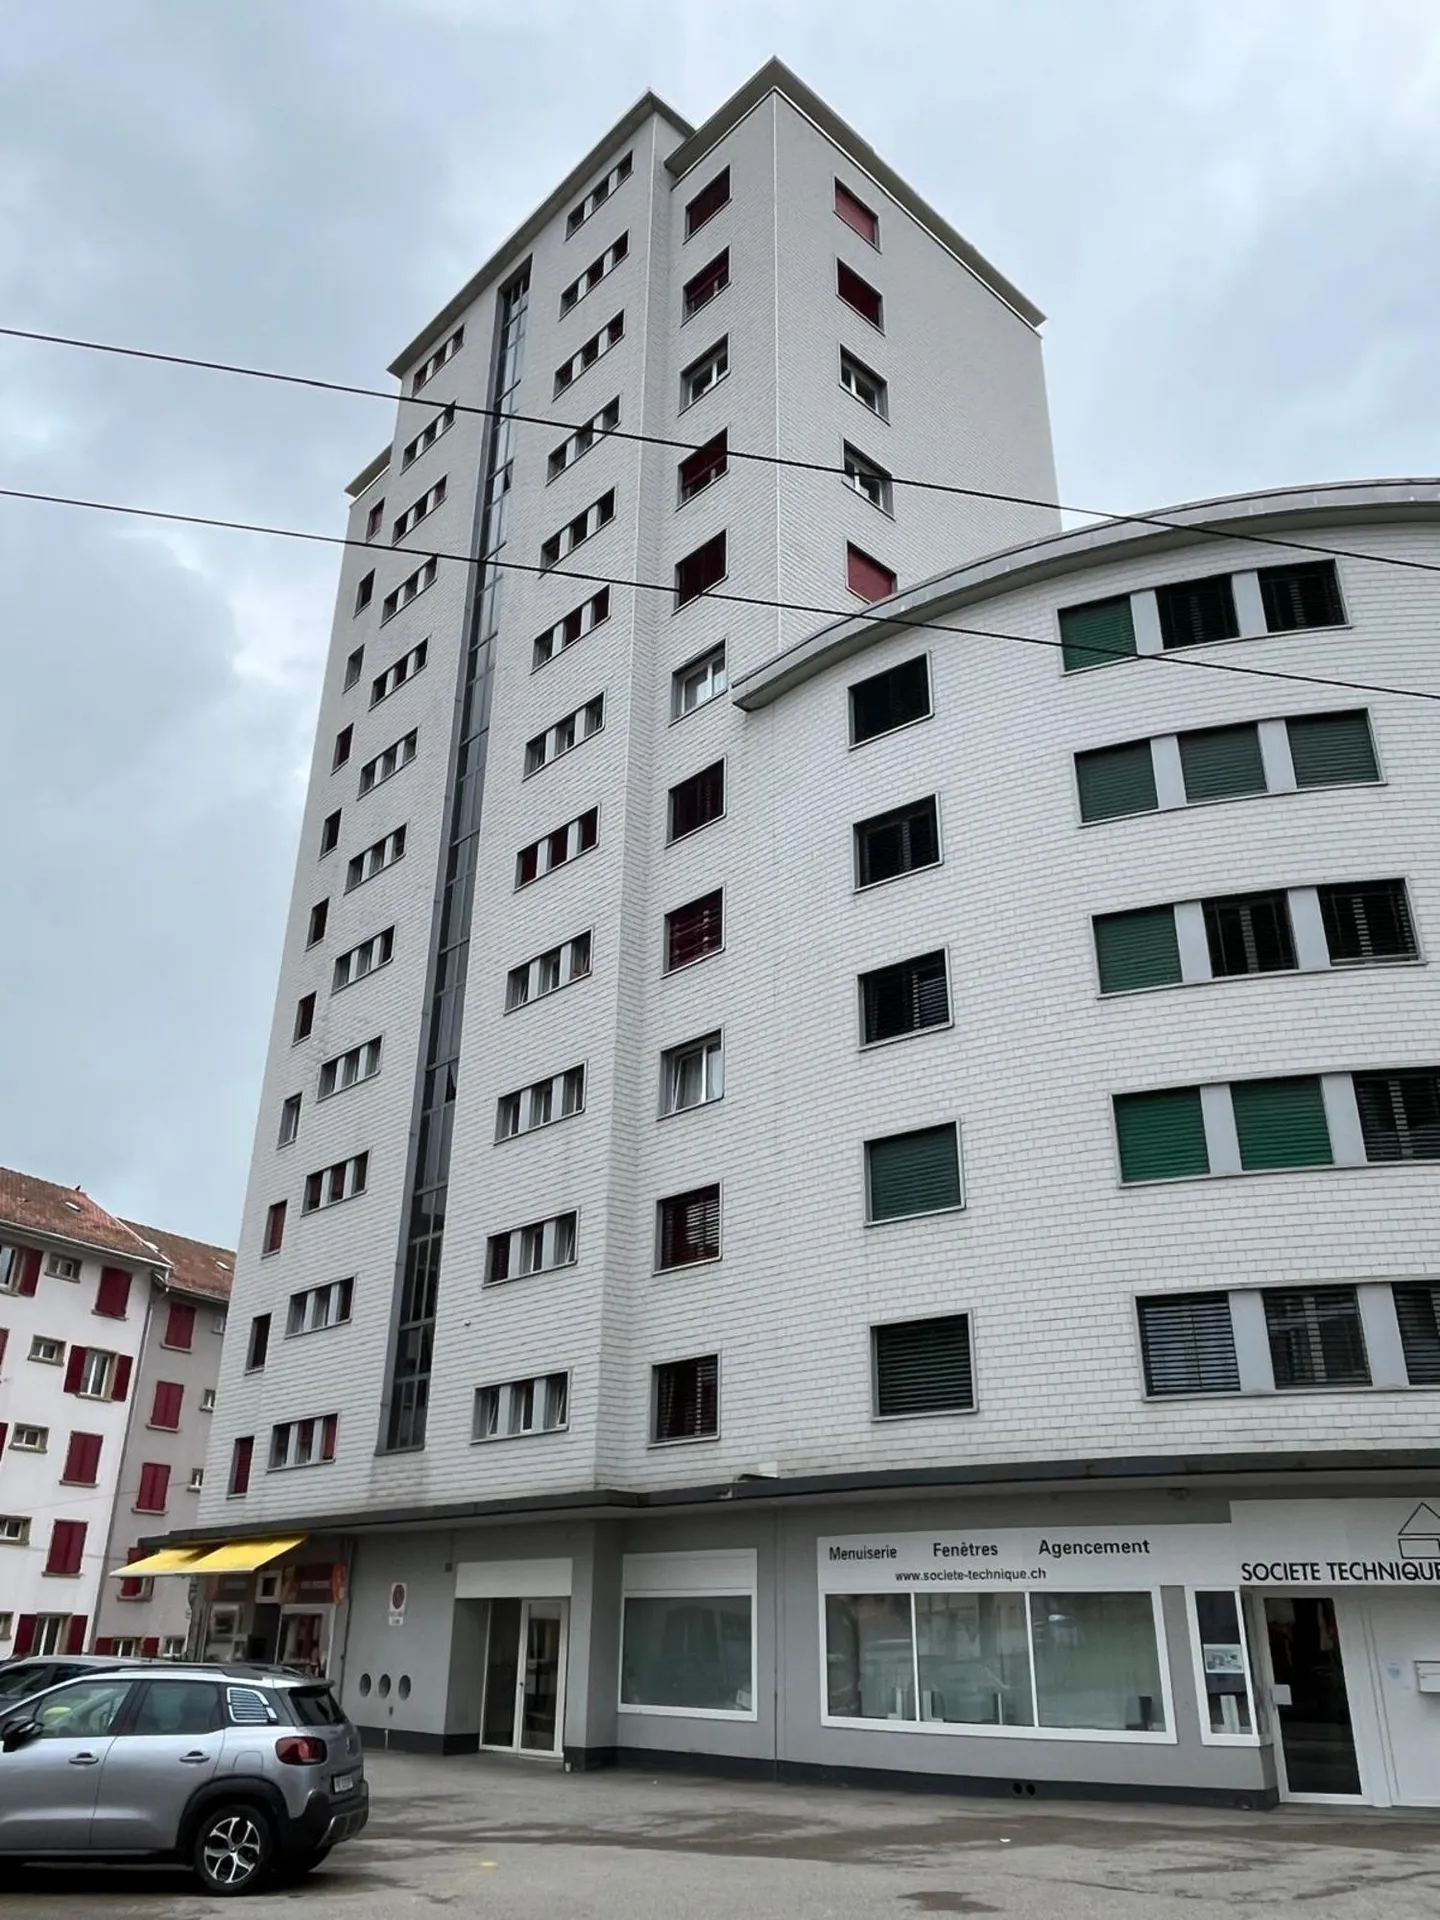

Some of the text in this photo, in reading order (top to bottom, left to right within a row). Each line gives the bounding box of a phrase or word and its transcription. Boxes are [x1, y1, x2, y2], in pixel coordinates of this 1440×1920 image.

[829, 1539, 1150, 1560] Menuiserie Fenêtres Agencement
[895, 1567, 1046, 1582] www.societe-technique.ch
[1241, 1562, 1321, 1581] SOCIETE
